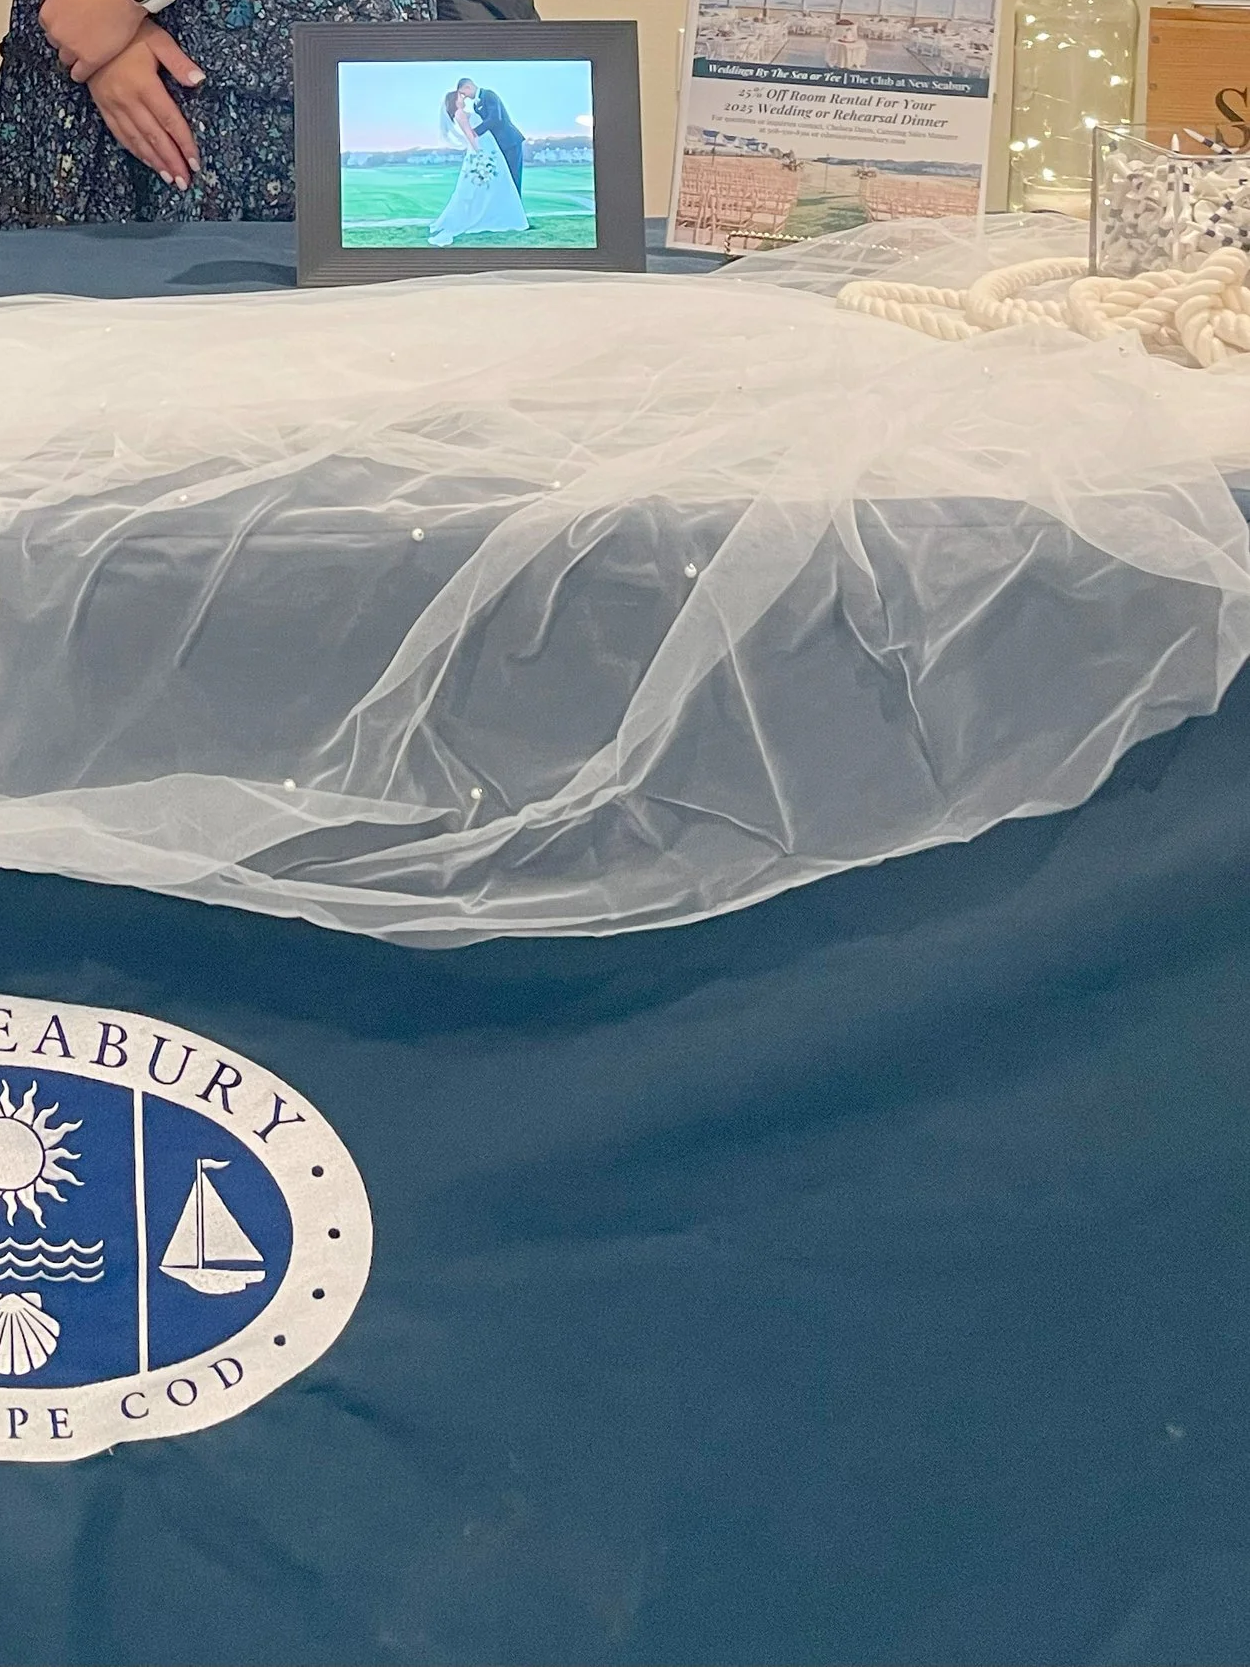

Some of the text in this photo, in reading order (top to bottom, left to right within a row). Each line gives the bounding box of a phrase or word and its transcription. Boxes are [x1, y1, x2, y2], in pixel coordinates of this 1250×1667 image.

[709, 64, 754, 77] Weddings
[771, 68, 788, 79] The
[790, 70, 809, 81] Sea
[809, 73, 823, 81] or
[850, 74, 869, 85] The
[870, 76, 894, 86] Club
[895, 78, 906, 87] at
[908, 78, 929, 89] New
[932, 81, 971, 92] Seabury
[766, 88, 791, 102] Off
[790, 90, 827, 104] Room
[829, 92, 873, 108] Rental
[875, 96, 900, 109] For
[903, 98, 937, 111] Your
[724, 102, 754, 115] 2025
[758, 102, 813, 119] Wedding
[832, 108, 899, 125] Rehearsal
[900, 114, 949, 128] Dinner
[120, 1355, 246, 1421] COD
